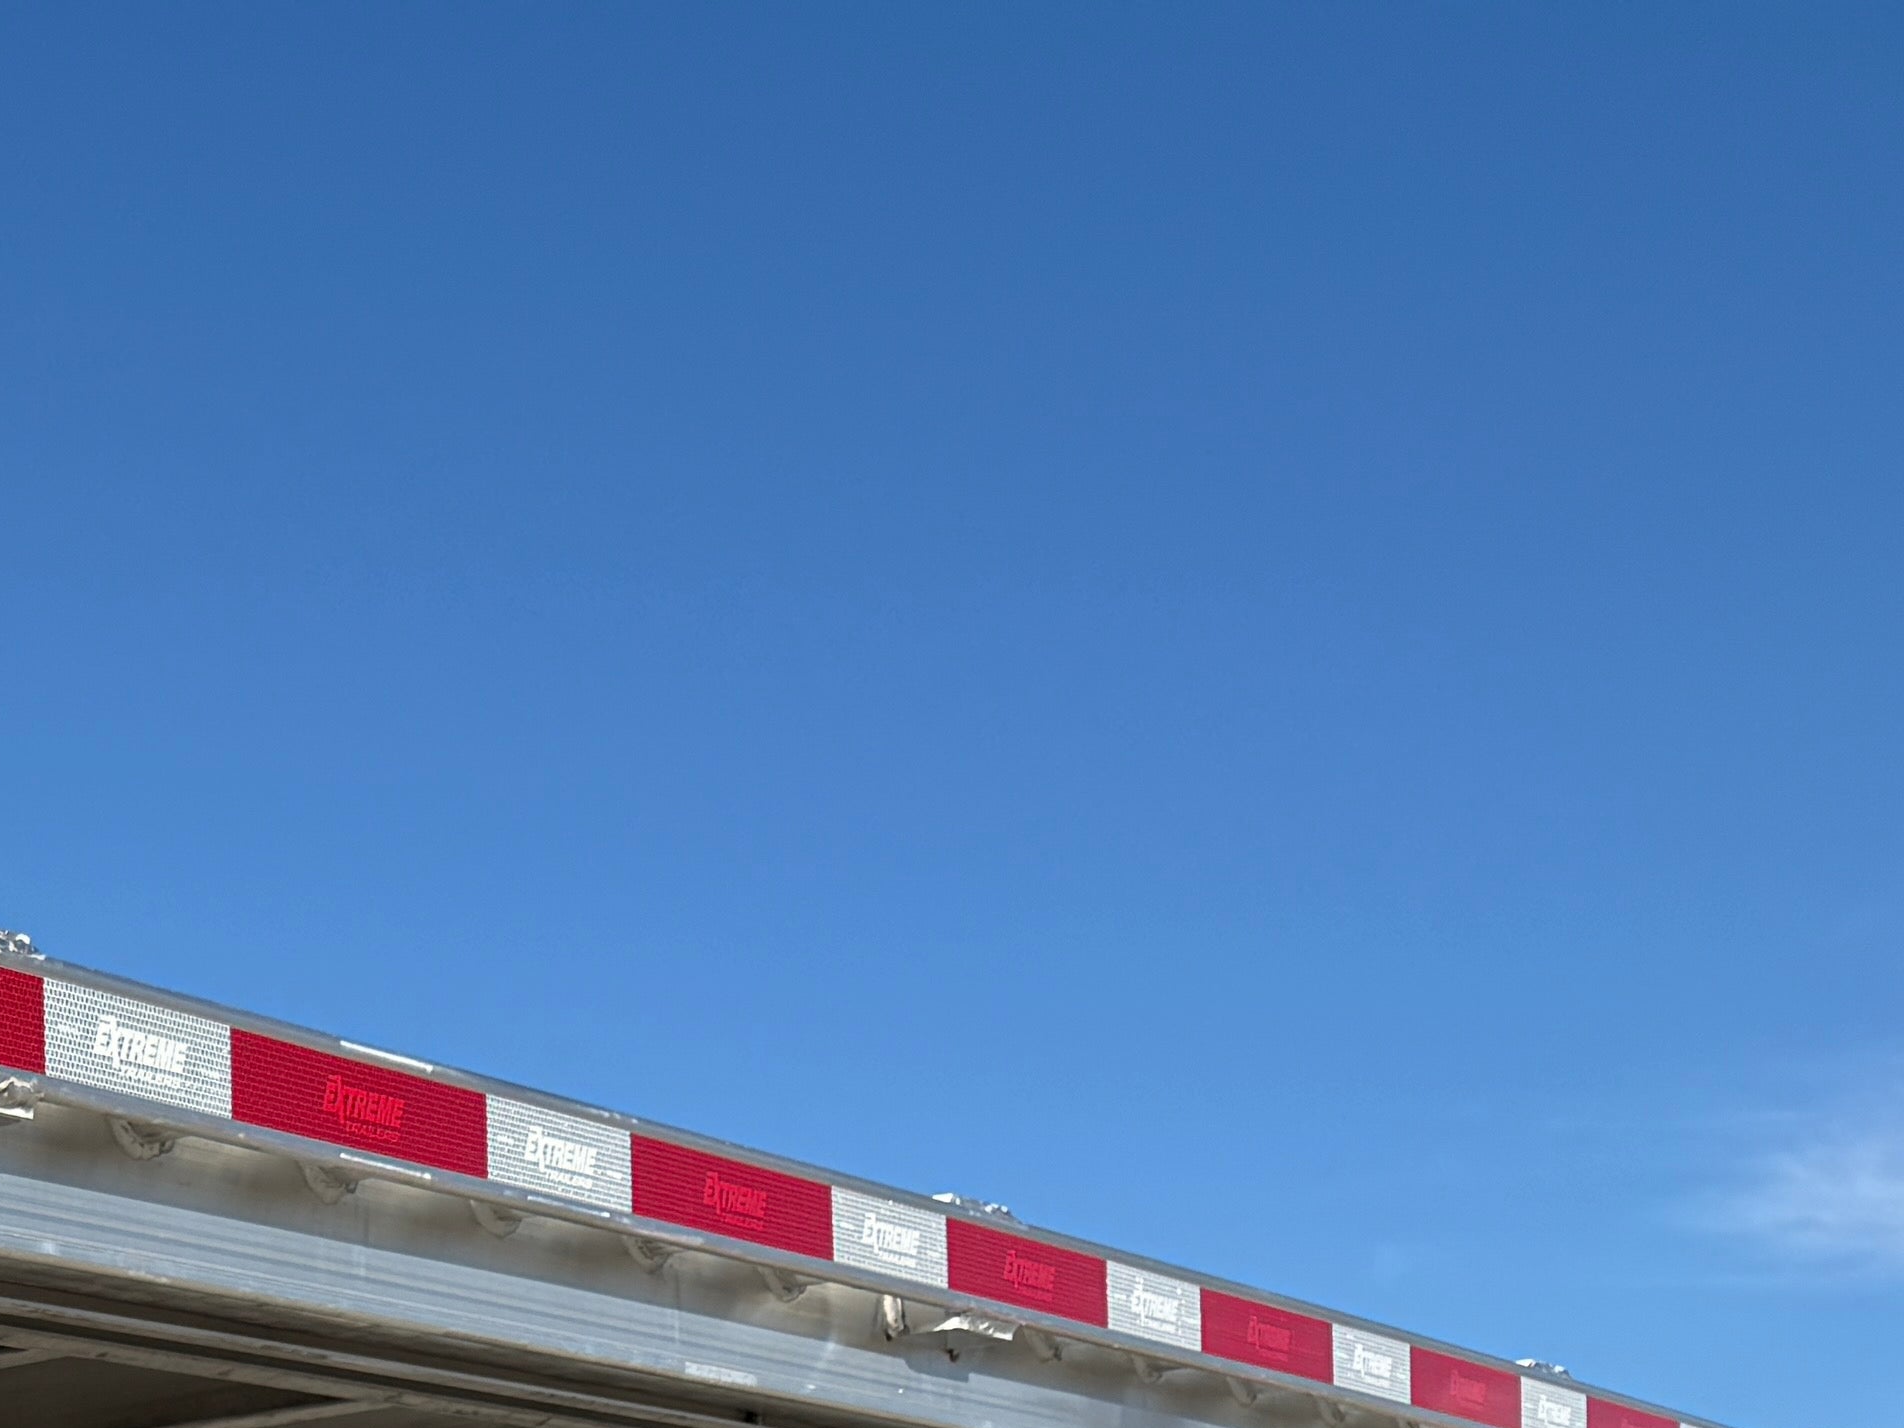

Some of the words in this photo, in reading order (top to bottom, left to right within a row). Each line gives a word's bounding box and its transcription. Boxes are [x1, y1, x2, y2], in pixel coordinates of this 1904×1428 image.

[94, 1015, 186, 1073] EXTREME
[323, 1074, 404, 1127] EXTREME
[524, 1125, 598, 1175] EXTREME
[703, 1171, 767, 1217] EXTREME
